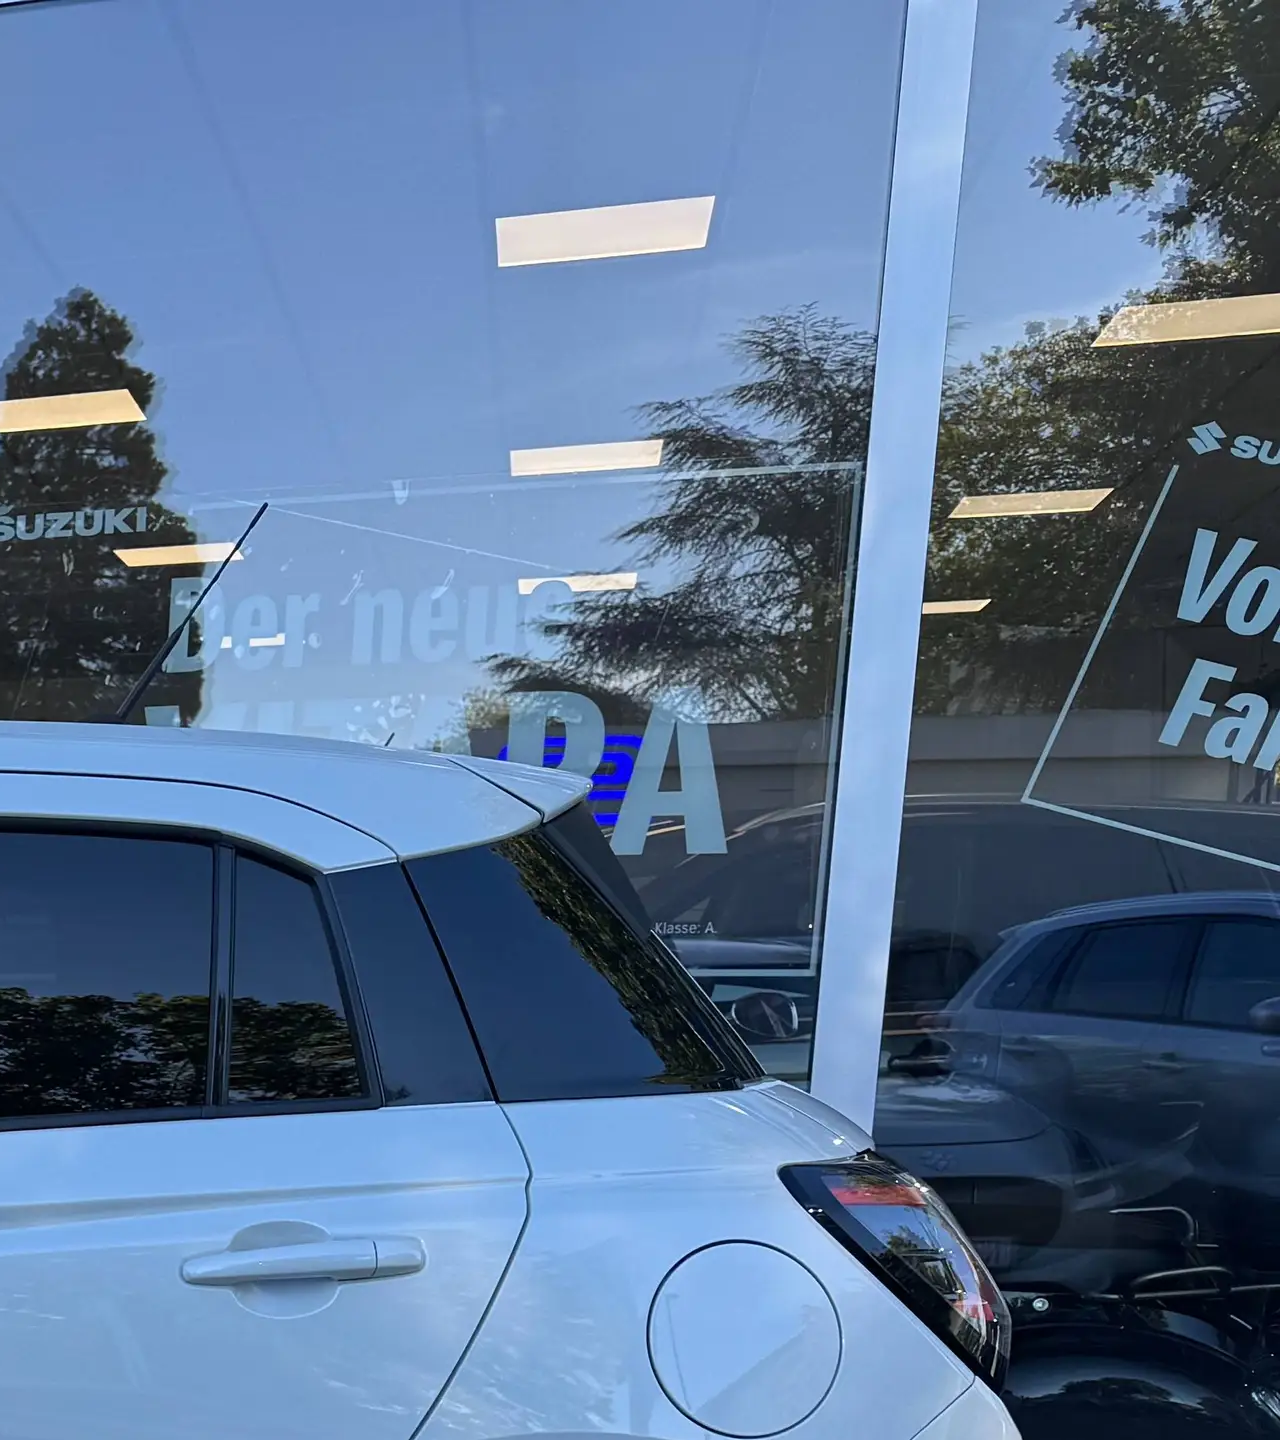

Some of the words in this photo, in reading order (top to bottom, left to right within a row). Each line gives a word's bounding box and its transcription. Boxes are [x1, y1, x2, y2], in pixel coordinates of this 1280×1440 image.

[163, 577, 320, 673] Der
[1177, 527, 1280, 643] Vo
[654, 921, 701, 934] Klasse:
